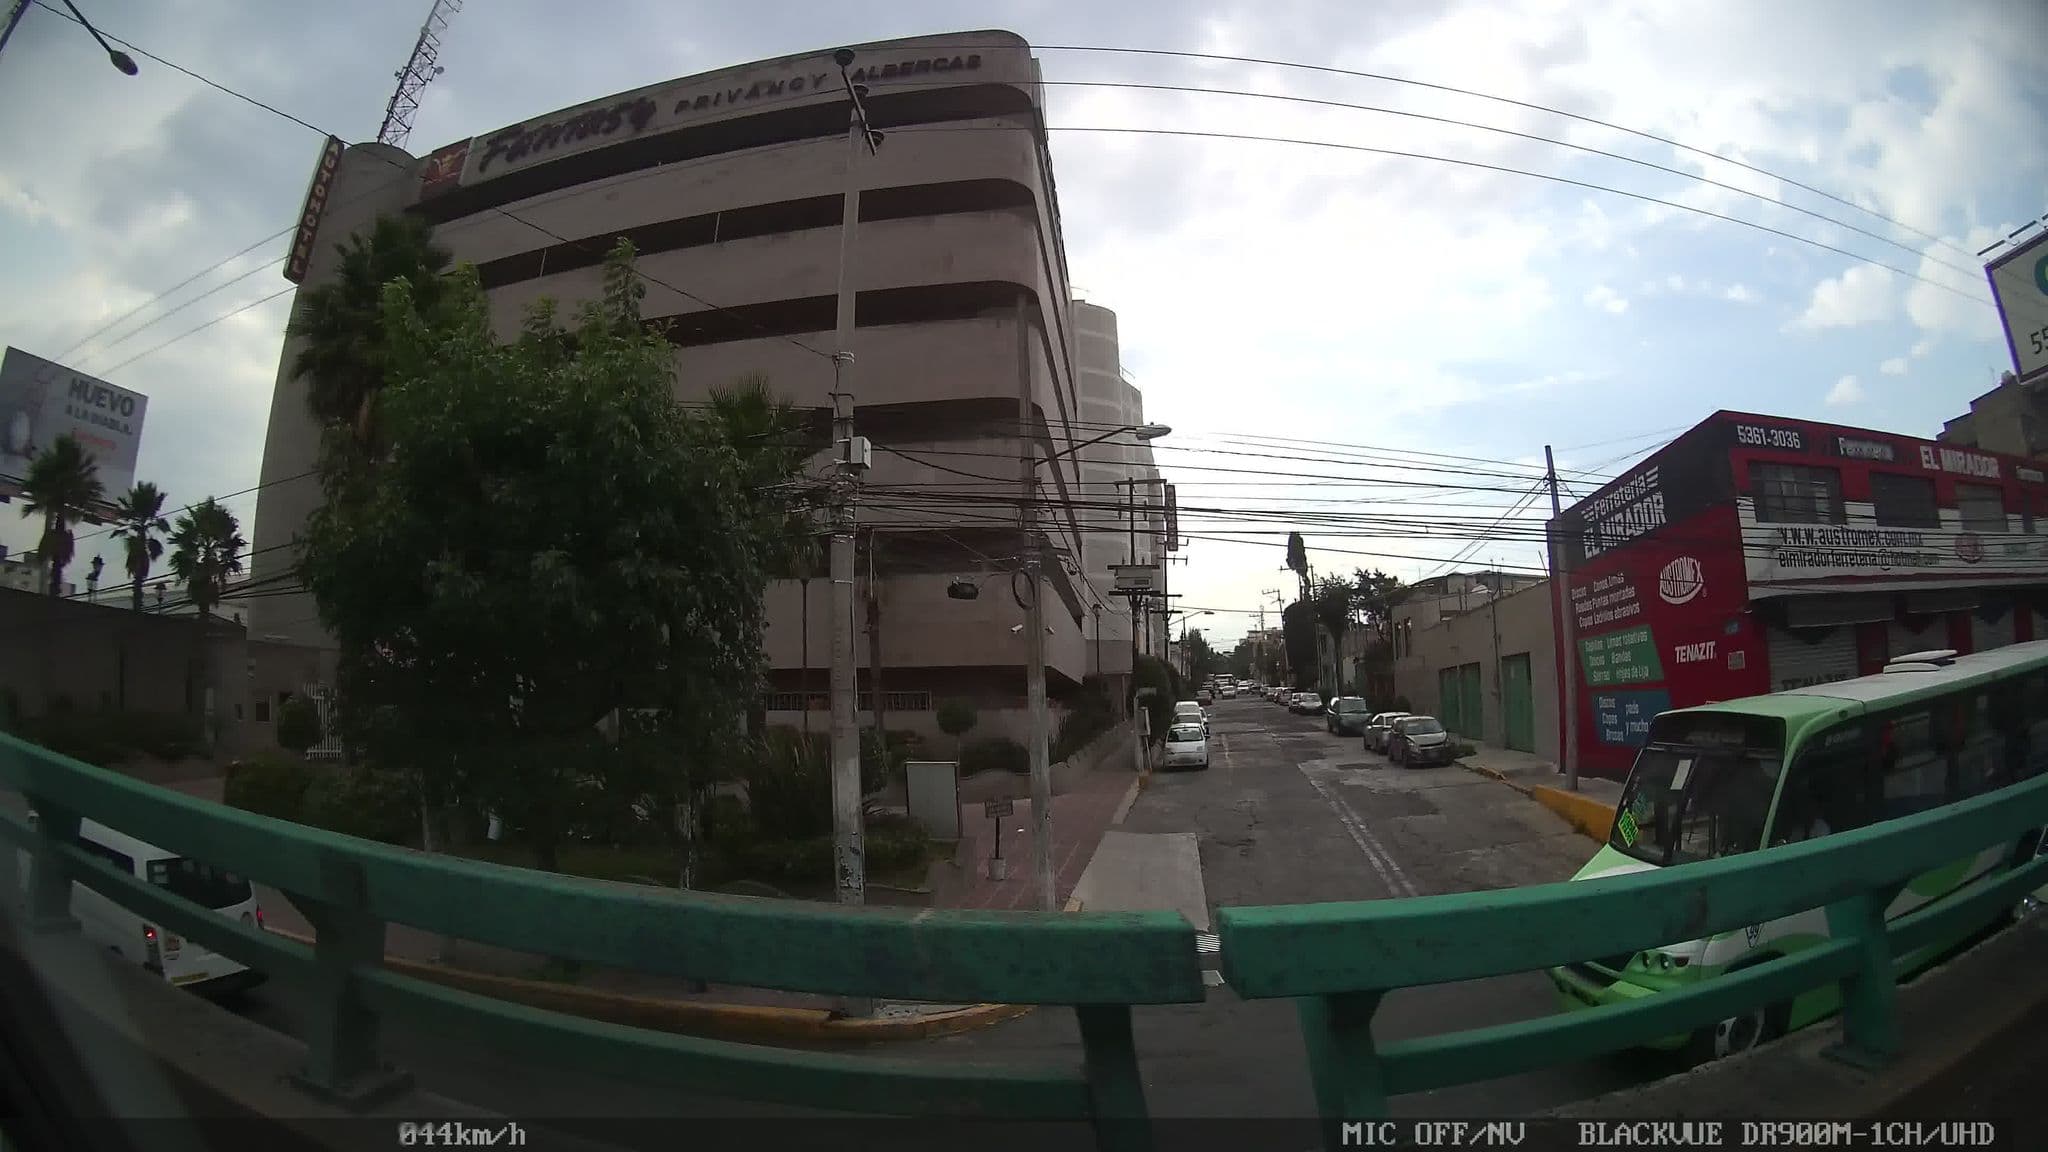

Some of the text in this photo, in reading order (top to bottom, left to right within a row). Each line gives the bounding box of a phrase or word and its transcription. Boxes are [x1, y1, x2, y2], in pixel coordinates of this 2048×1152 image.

[67, 376, 136, 417] HUEVO
[1736, 424, 1800, 449] 5361-3036
[1919, 445, 1941, 471] EL
[1940, 448, 2000, 479] MIRADOR
[1600, 490, 1667, 551] MIRADOR
[1659, 556, 1704, 600] AUSTROMEX
[1674, 640, 1716, 664] TENAZIT
